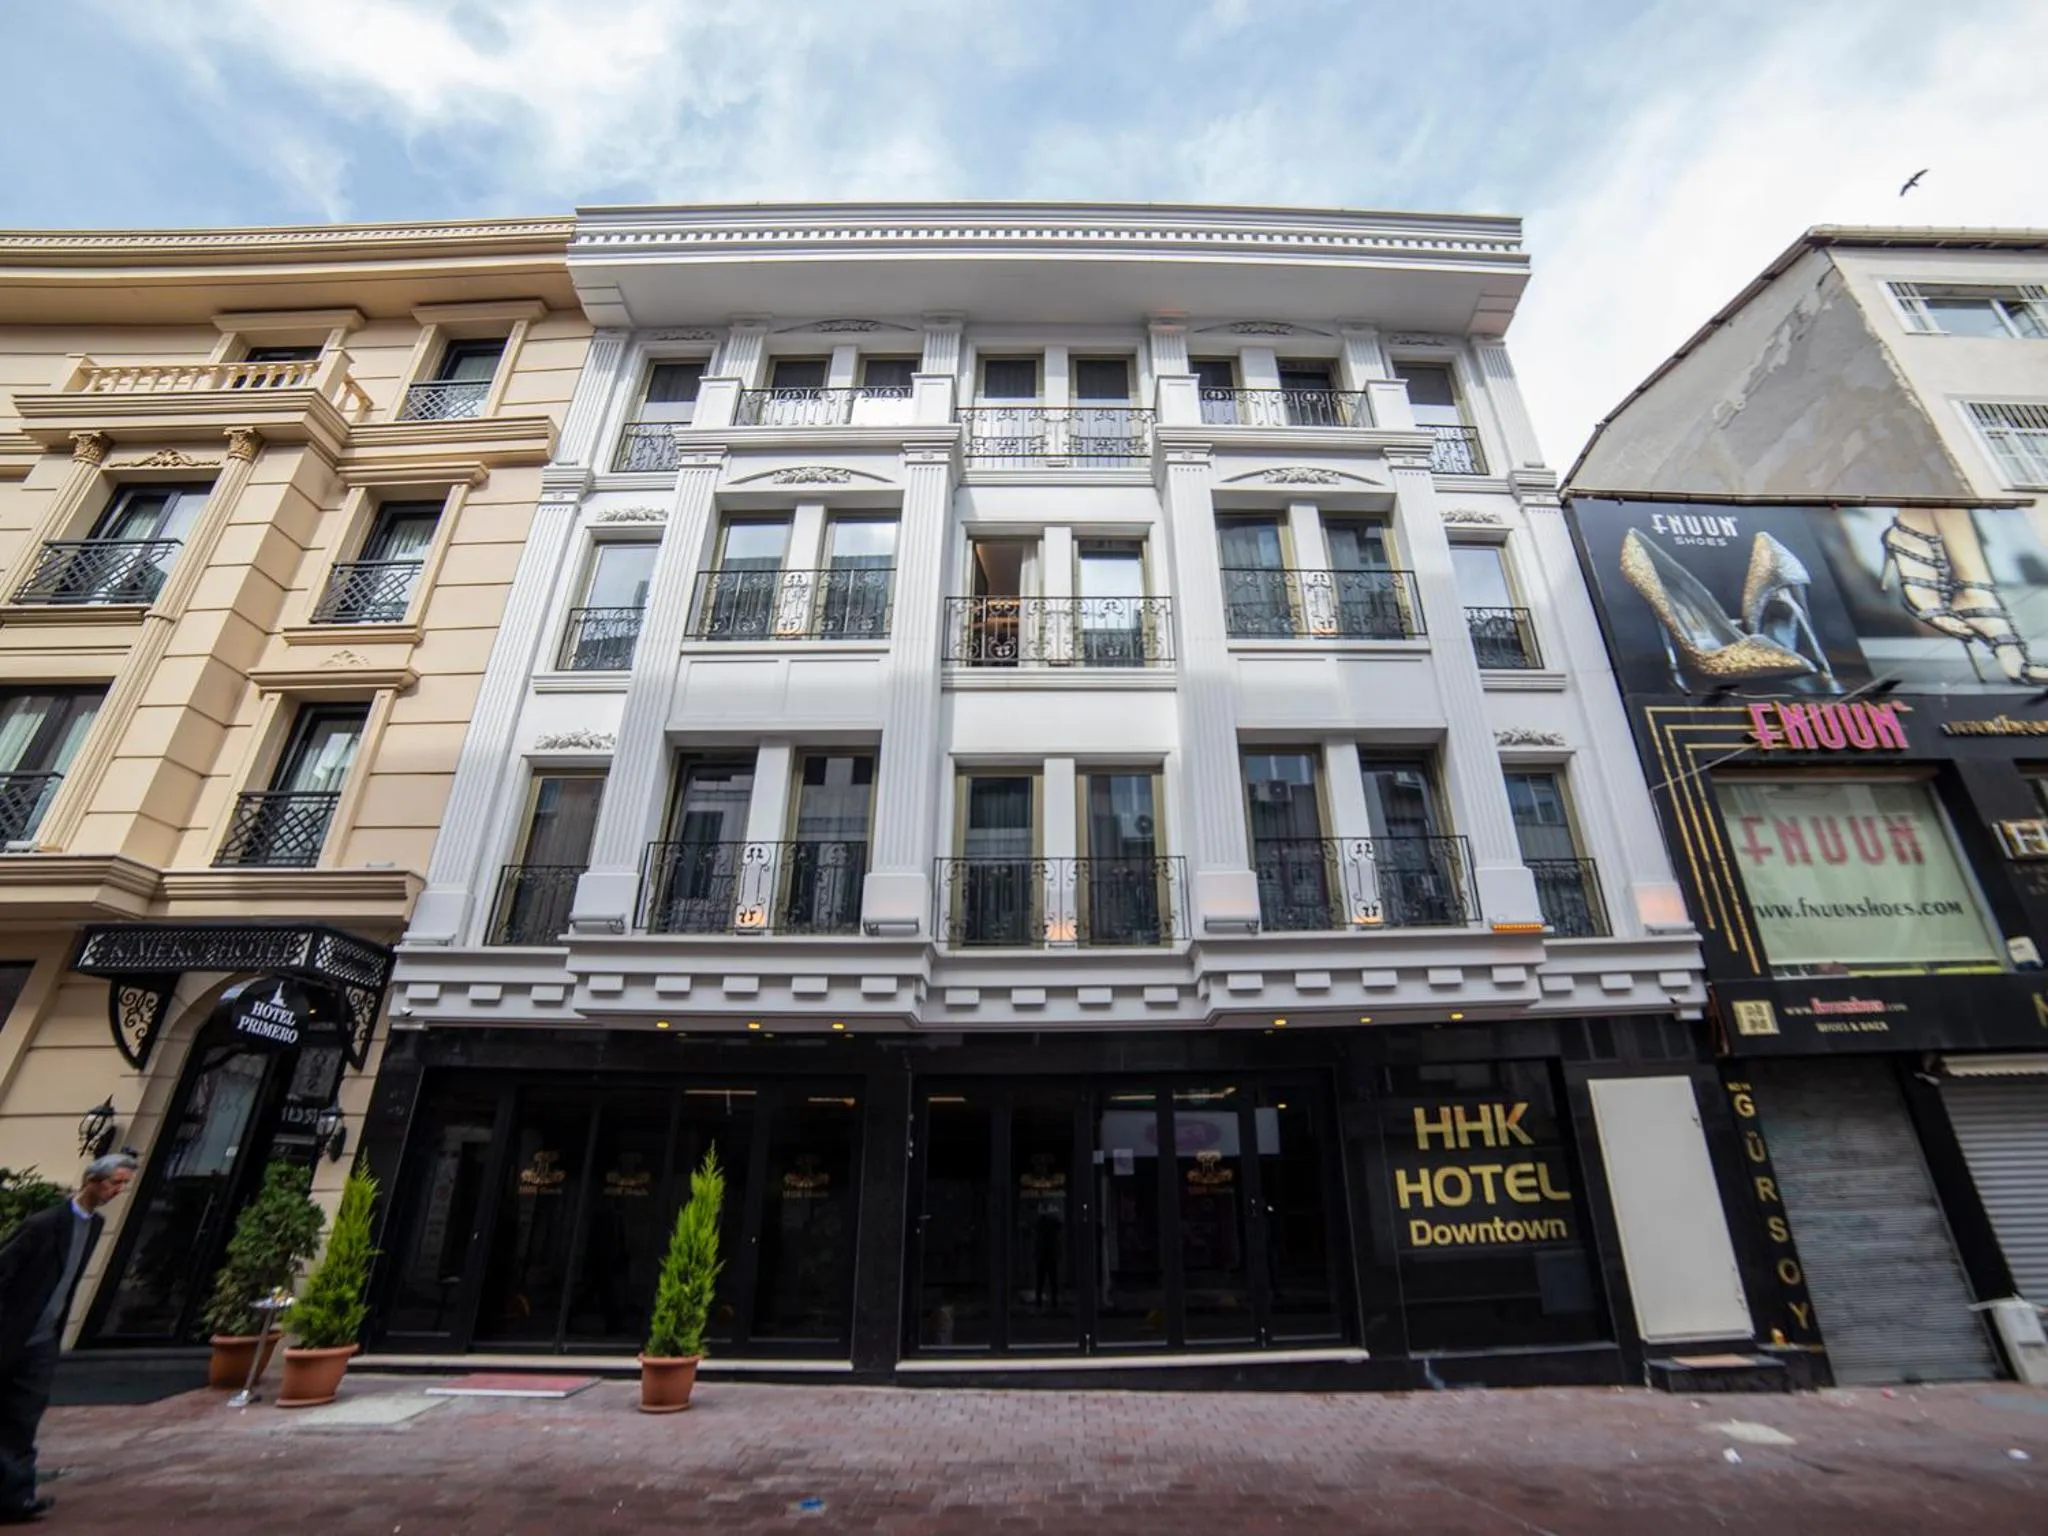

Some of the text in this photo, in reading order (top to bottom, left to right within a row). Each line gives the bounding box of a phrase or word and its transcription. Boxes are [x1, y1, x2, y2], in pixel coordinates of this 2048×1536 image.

[1674, 536, 1728, 547] SHOES
[1753, 896, 1963, 919] ww.fnuunshoes.com
[250, 1000, 297, 1026] HOTEL
[237, 1014, 299, 1044] PRIMERO
[1413, 1101, 1535, 1150] HHK
[1396, 1161, 1571, 1211] HOTEL
[1732, 1091, 1813, 1331] GÜRSOY
[1410, 1216, 1568, 1247] Downtown
